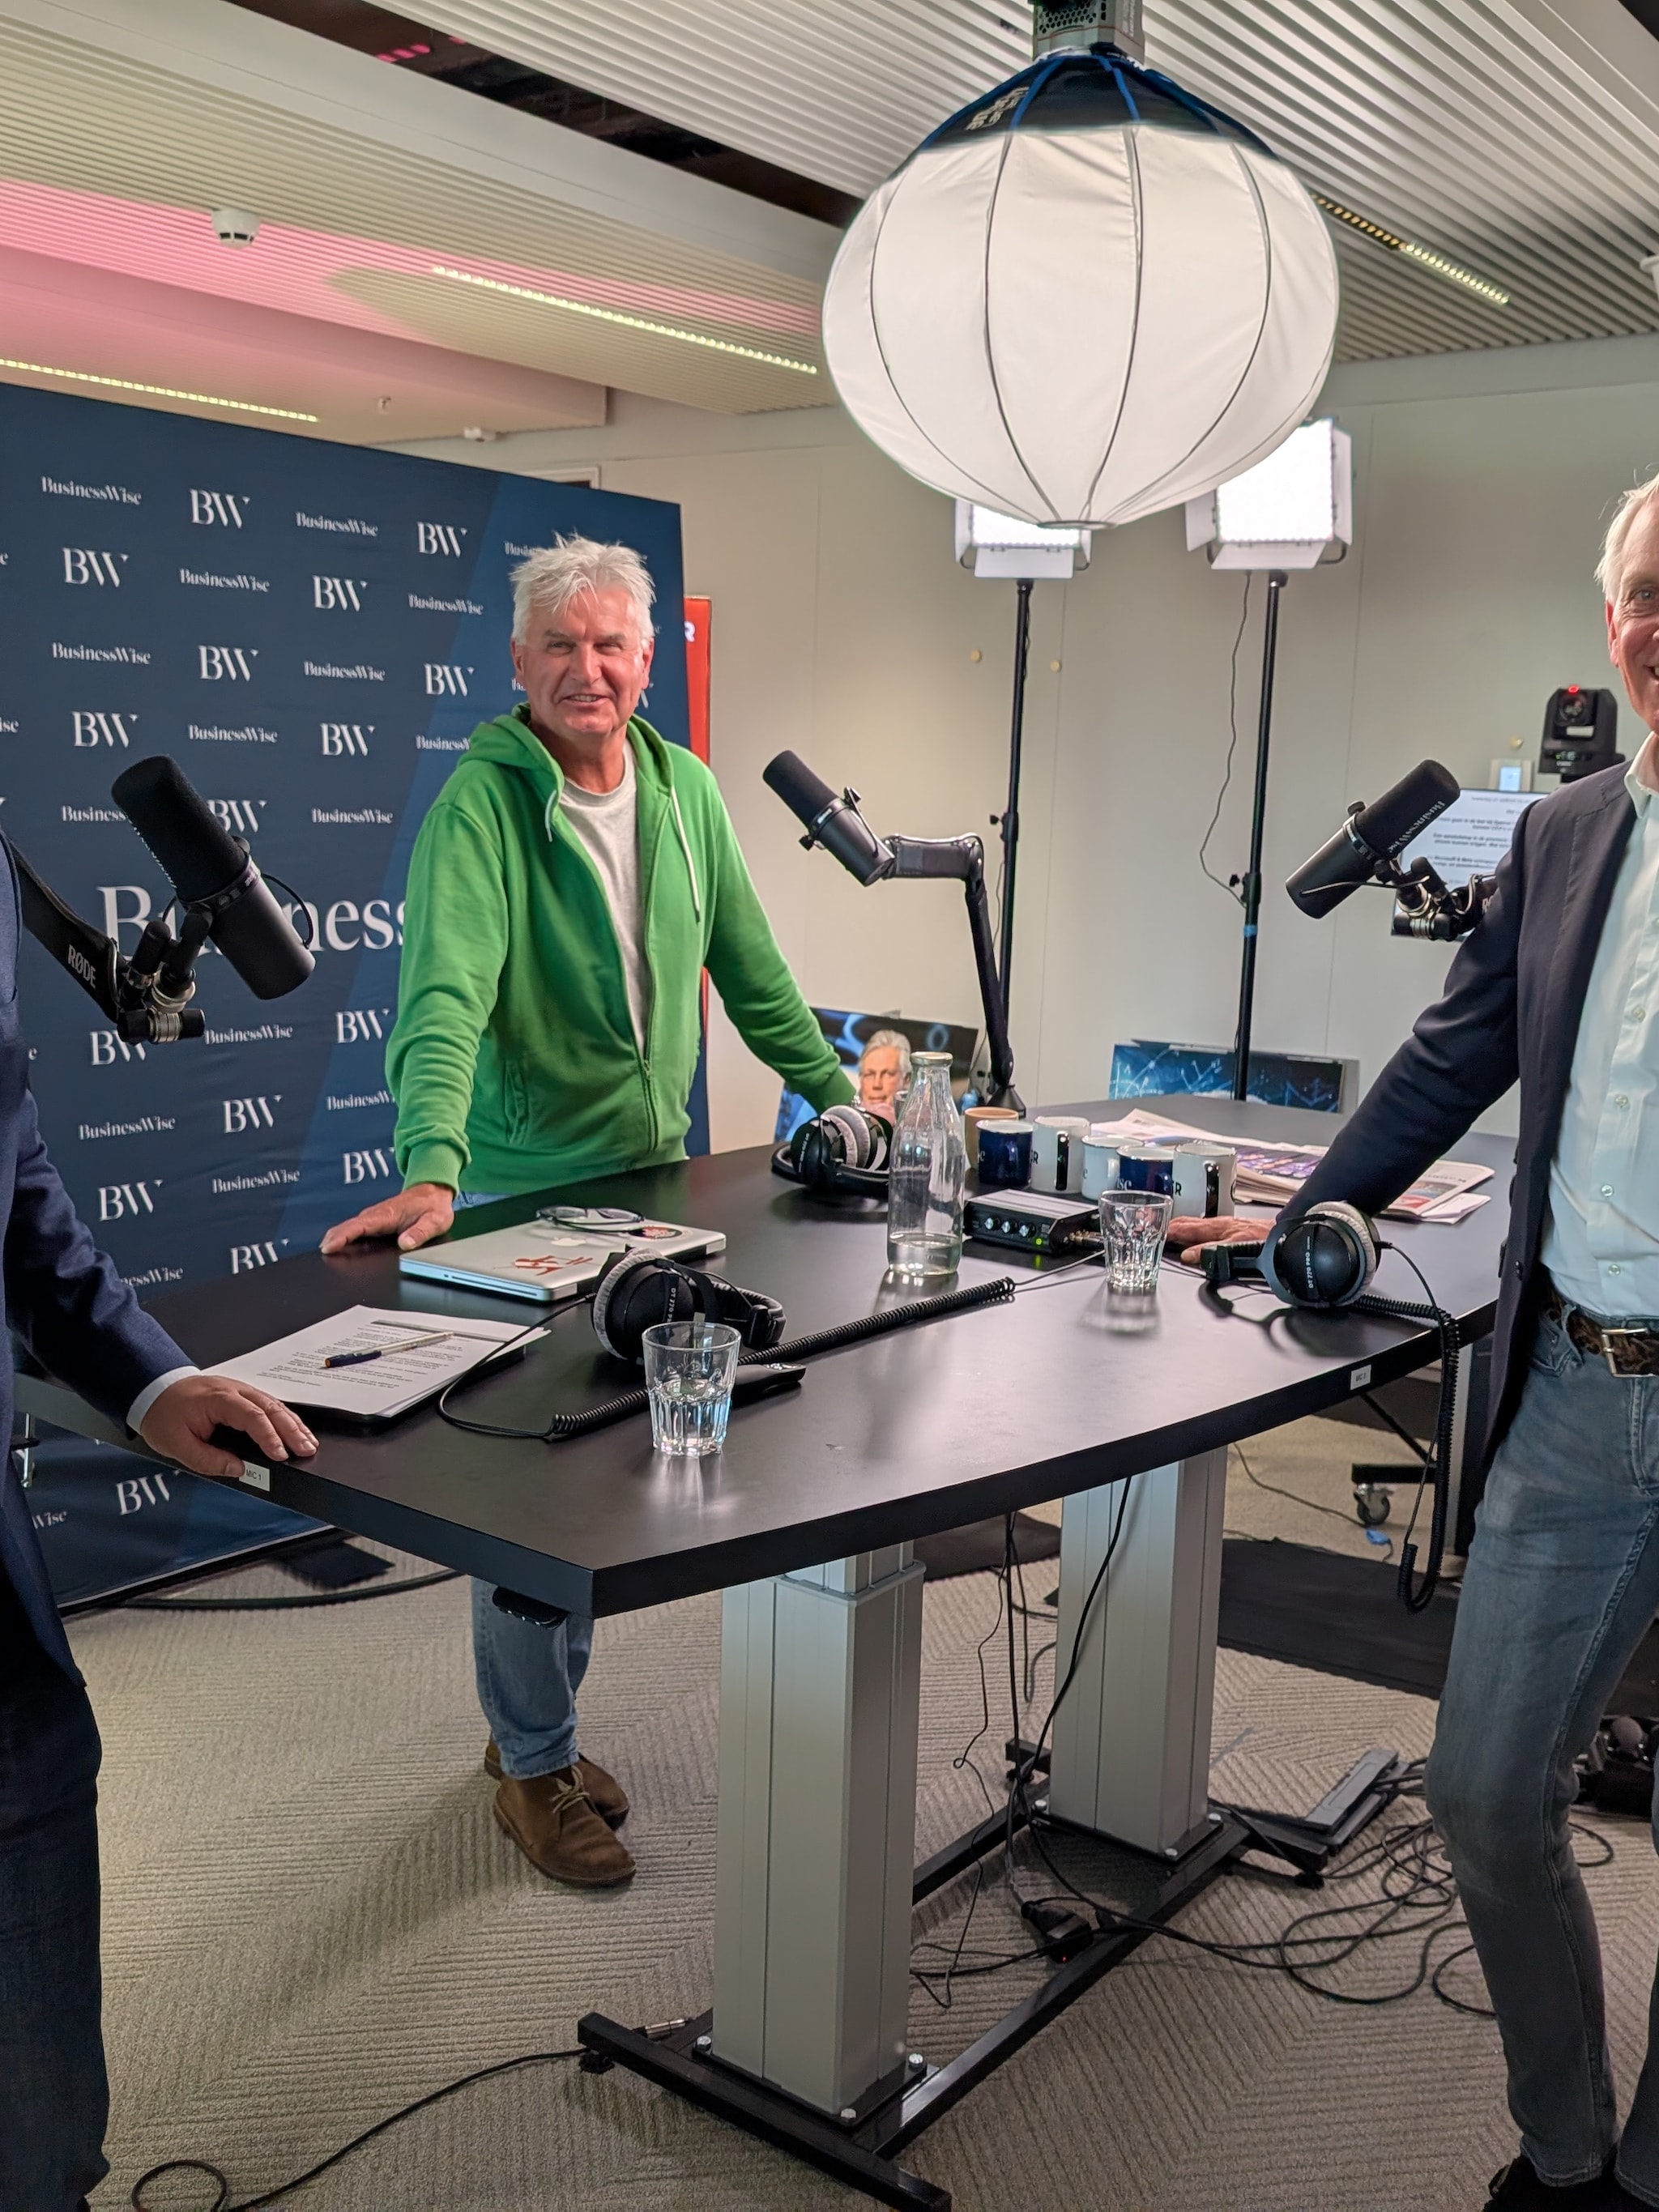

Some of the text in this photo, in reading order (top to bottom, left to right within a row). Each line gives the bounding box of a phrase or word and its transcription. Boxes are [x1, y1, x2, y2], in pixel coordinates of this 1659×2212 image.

[41, 476, 142, 505] BusinessWise
[190, 489, 250, 529] BW
[296, 512, 378, 537] BusinessWise
[417, 522, 467, 557] BW
[62, 548, 129, 587] BW
[180, 568, 270, 592] BusinessWise
[313, 575, 368, 612] BW
[407, 594, 484, 616] BusinessWise
[52, 642, 151, 665] BusinessWise
[198, 645, 258, 681] BW
[304, 661, 386, 681] BusinessWise
[424, 663, 474, 697] BW
[72, 711, 138, 748] BW
[189, 724, 278, 743] BusinessWise
[321, 722, 375, 757] BW
[416, 735, 471, 750] BusinessW
[62, 805, 126, 822] Business
[208, 799, 267, 833] BW
[312, 808, 393, 824] BusinessWise
[97, 885, 405, 961] Bnes
[68, 944, 96, 990] RØDE
[205, 1025, 293, 1045] BusinessWise
[335, 1008, 389, 1043] BW
[223, 1094, 282, 1133] BW
[326, 1090, 394, 1110] BusinessW
[79, 1116, 176, 1140] BusinessWise
[343, 1147, 394, 1184] BW
[212, 1169, 301, 1194] BusinessWise
[99, 1179, 163, 1221] BW
[122, 1268, 184, 1287] nessWise
[1307, 1280, 1314, 1289] DT
[671, 1287, 676, 1298] DT
[246, 1468, 257, 1480] MIC
[116, 1470, 179, 1515] BW
